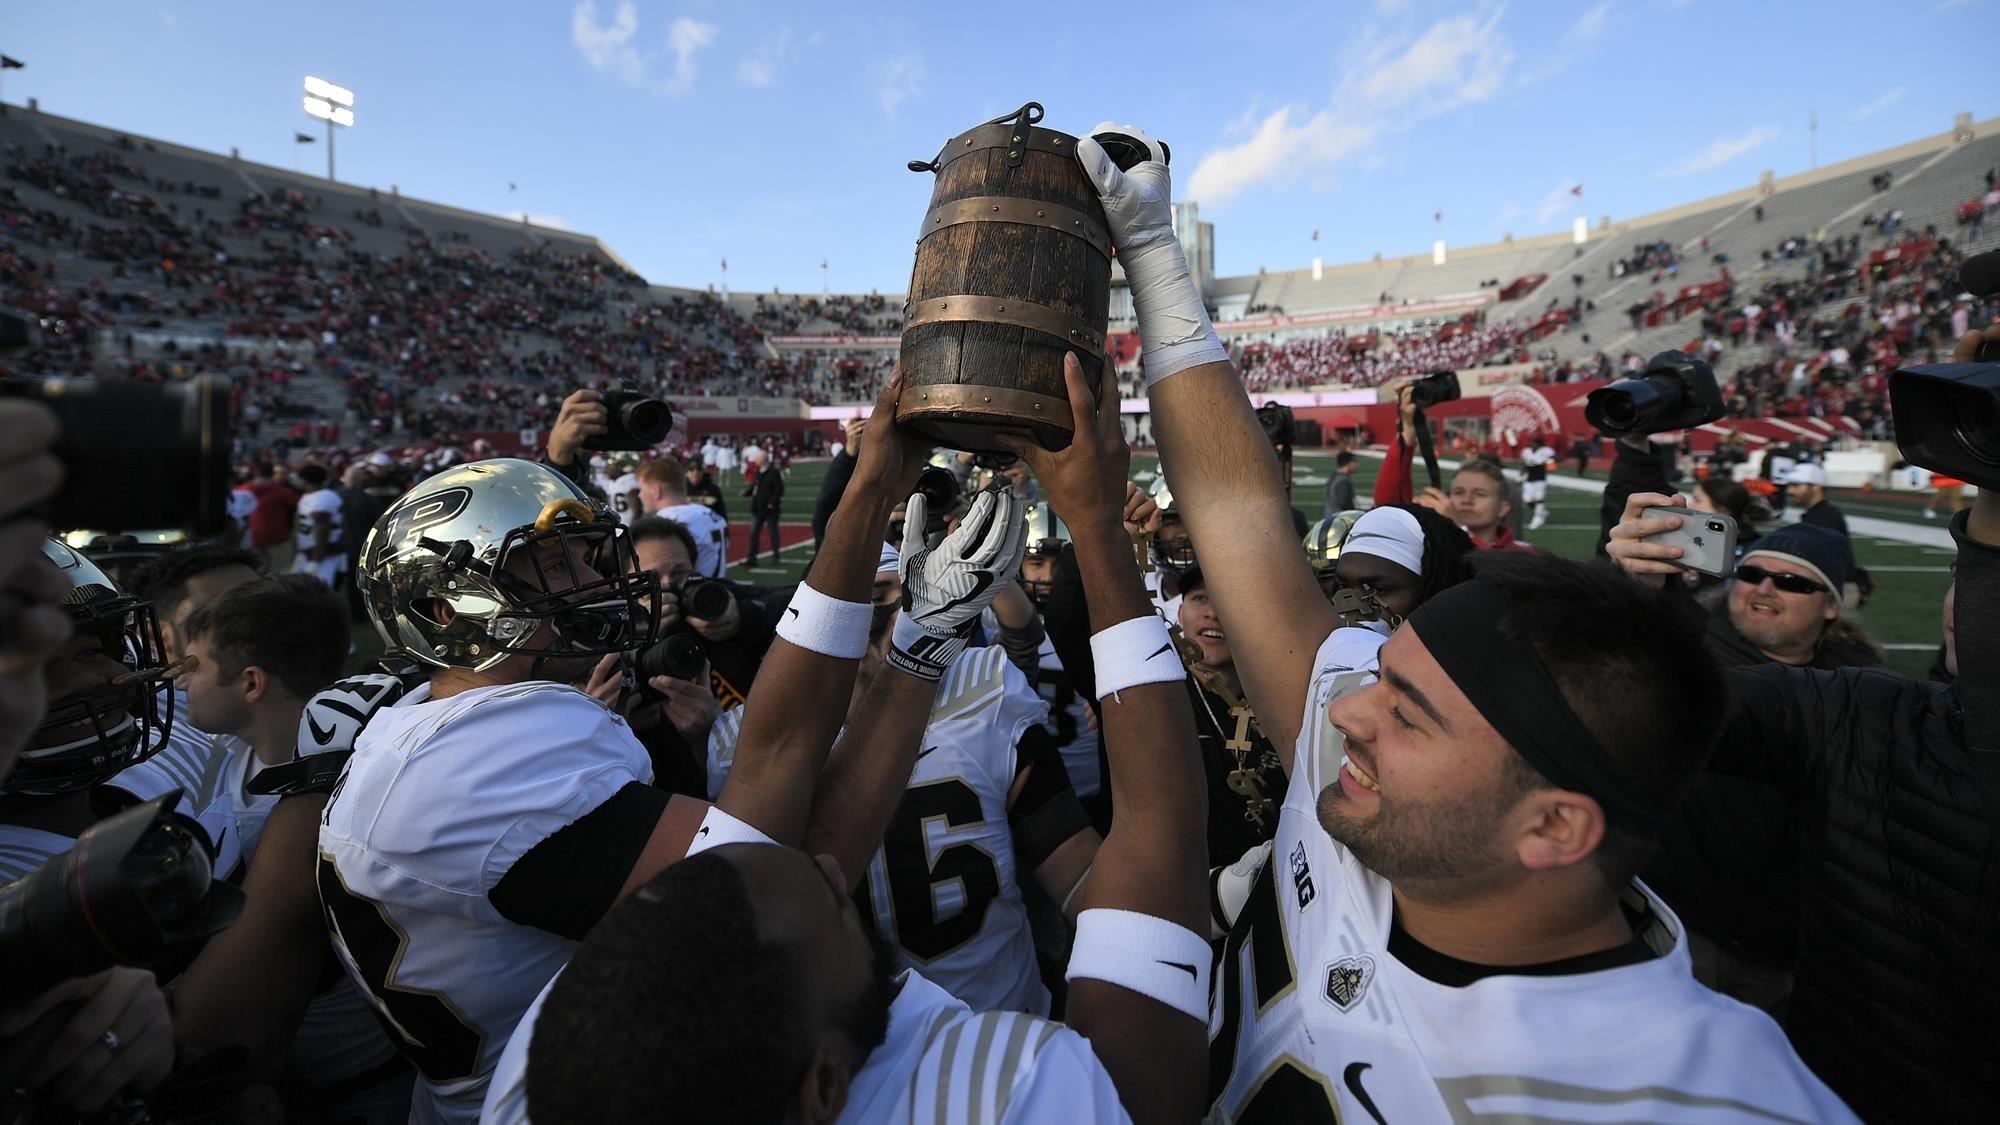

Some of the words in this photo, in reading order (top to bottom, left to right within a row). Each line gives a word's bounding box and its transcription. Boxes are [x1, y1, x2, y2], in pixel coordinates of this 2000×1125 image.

[376, 486, 473, 570] P
[889, 649, 918, 671] FOOTBALL
[866, 776, 1002, 966] 6
[1330, 968, 1351, 1005] PURDUE
